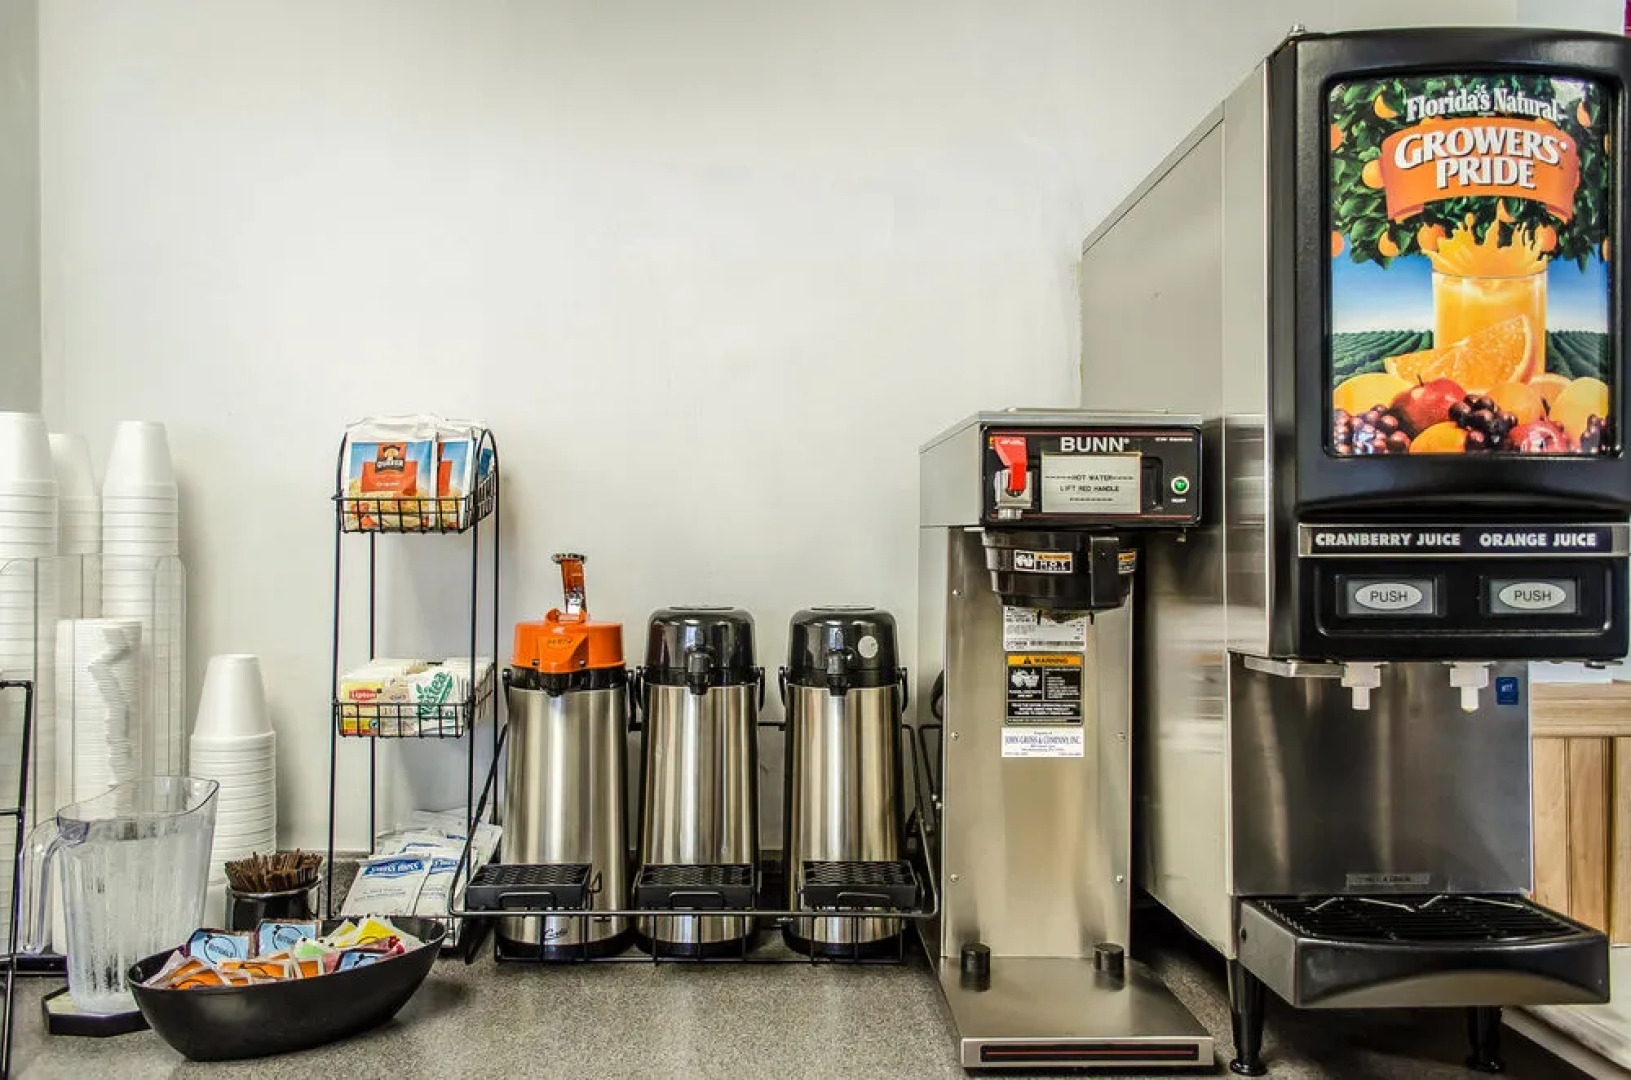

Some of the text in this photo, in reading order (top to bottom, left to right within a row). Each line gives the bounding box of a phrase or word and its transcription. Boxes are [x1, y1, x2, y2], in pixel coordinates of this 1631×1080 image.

[1406, 85, 1559, 121] Florida's Natural
[1436, 156, 1536, 189] PRIDE
[1089, 474, 1112, 482] WATER
[1315, 533, 1460, 546] CRANBERRY JUICE
[1479, 532, 1597, 546] ORANGE JUICE
[1370, 591, 1408, 603] PUSH
[1514, 590, 1552, 602] PUSH
